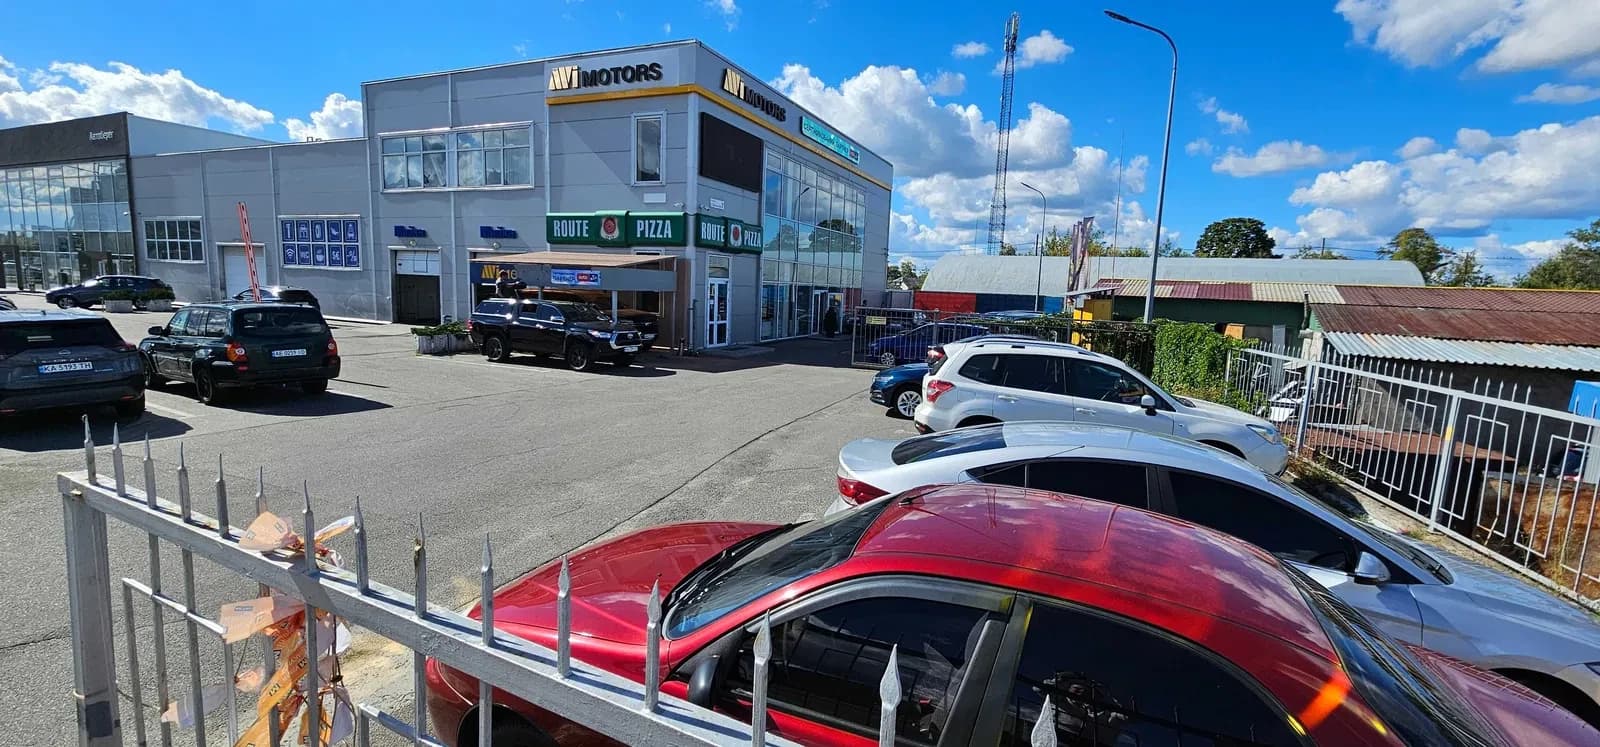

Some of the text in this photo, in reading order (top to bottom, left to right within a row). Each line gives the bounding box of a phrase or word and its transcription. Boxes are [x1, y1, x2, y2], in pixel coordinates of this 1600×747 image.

[582, 63, 662, 87] MOTORS
[745, 89, 786, 121] MOTORS
[553, 219, 672, 238] ROUTE PIZZA
[701, 222, 761, 248] ROUTE PIZZA
